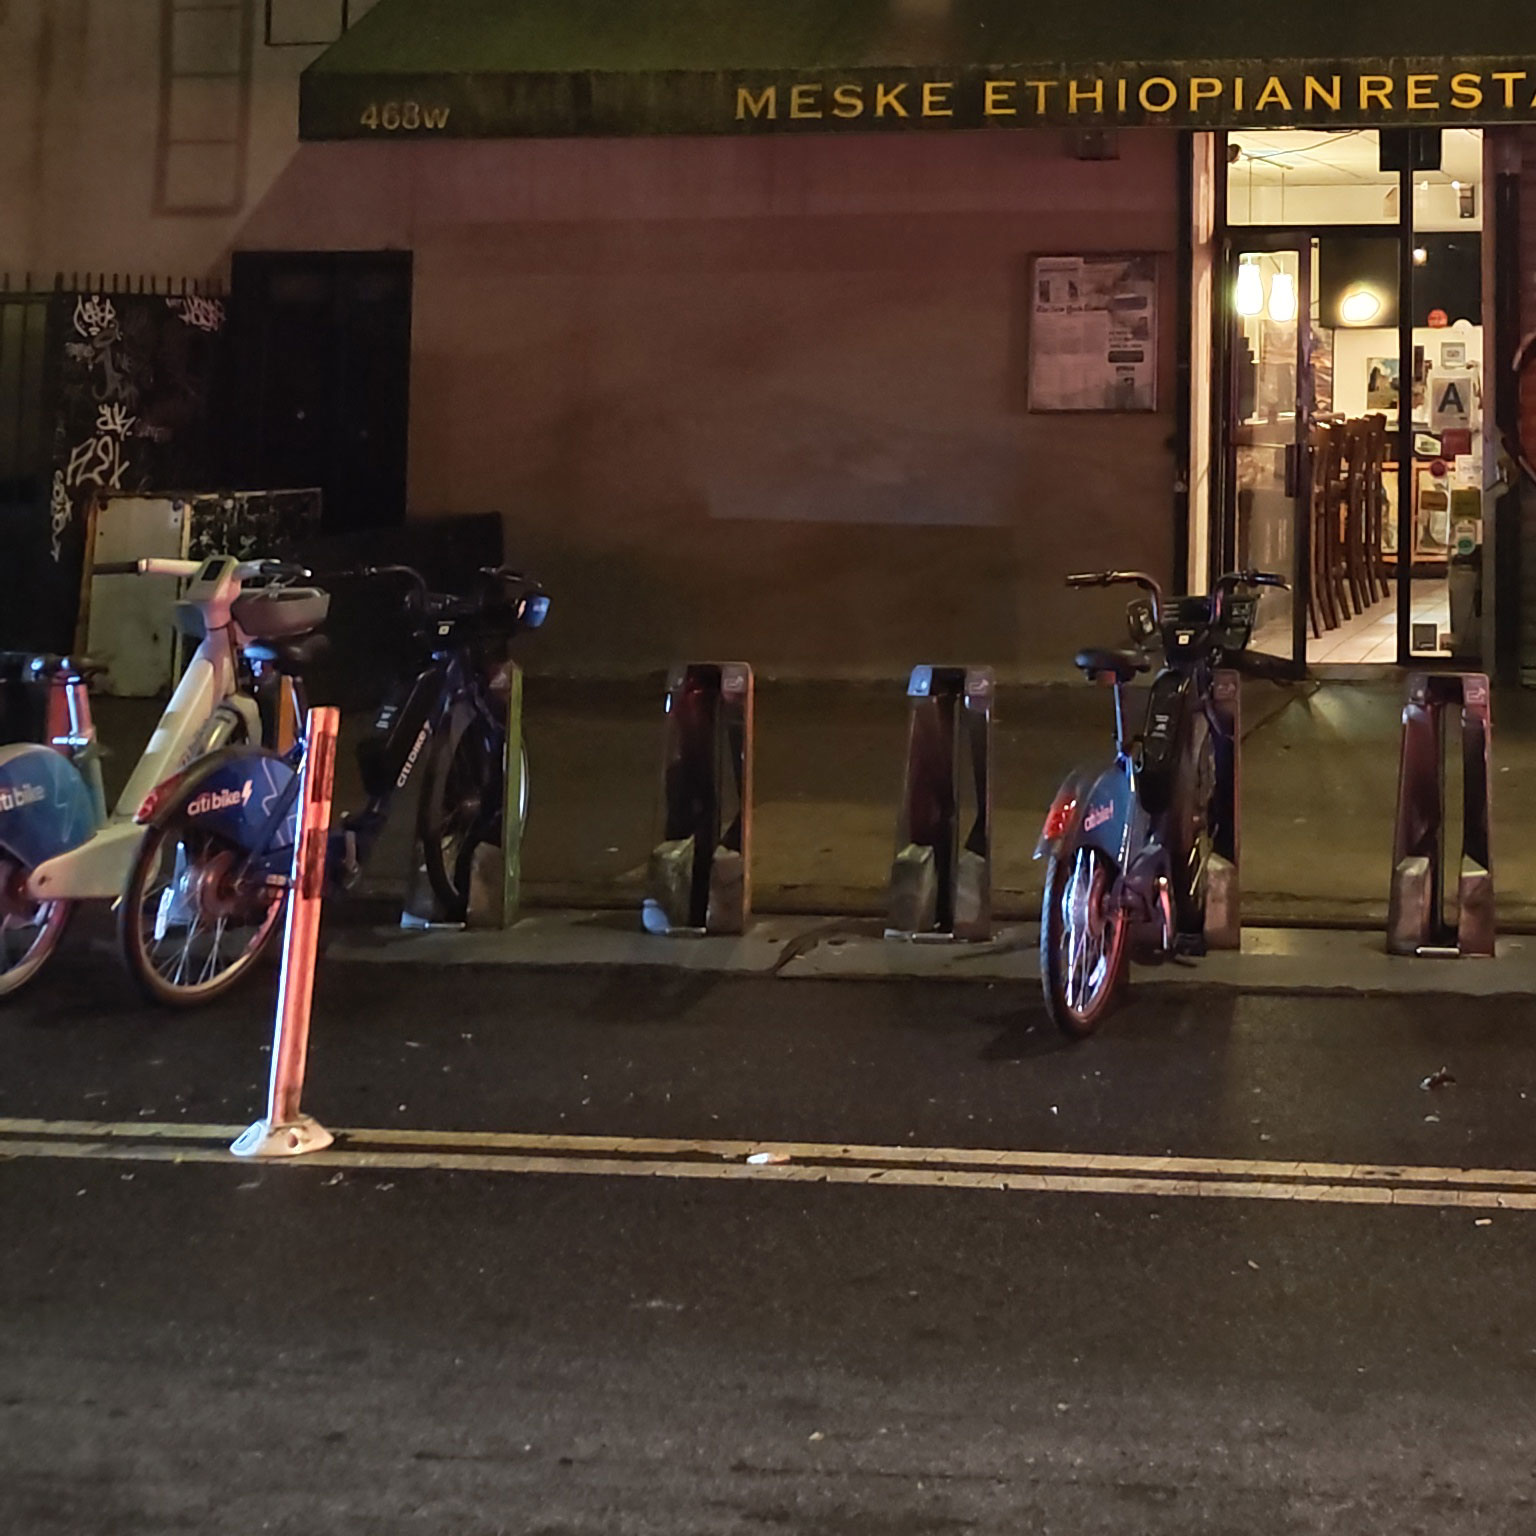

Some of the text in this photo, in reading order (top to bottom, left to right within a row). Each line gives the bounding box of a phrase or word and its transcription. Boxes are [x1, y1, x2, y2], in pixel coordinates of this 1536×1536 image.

[735, 83, 955, 120] MESKE
[984, 75, 1343, 115] ETHIOPIAN
[1438, 382, 1465, 414] A
[187, 789, 242, 816] citi bike
